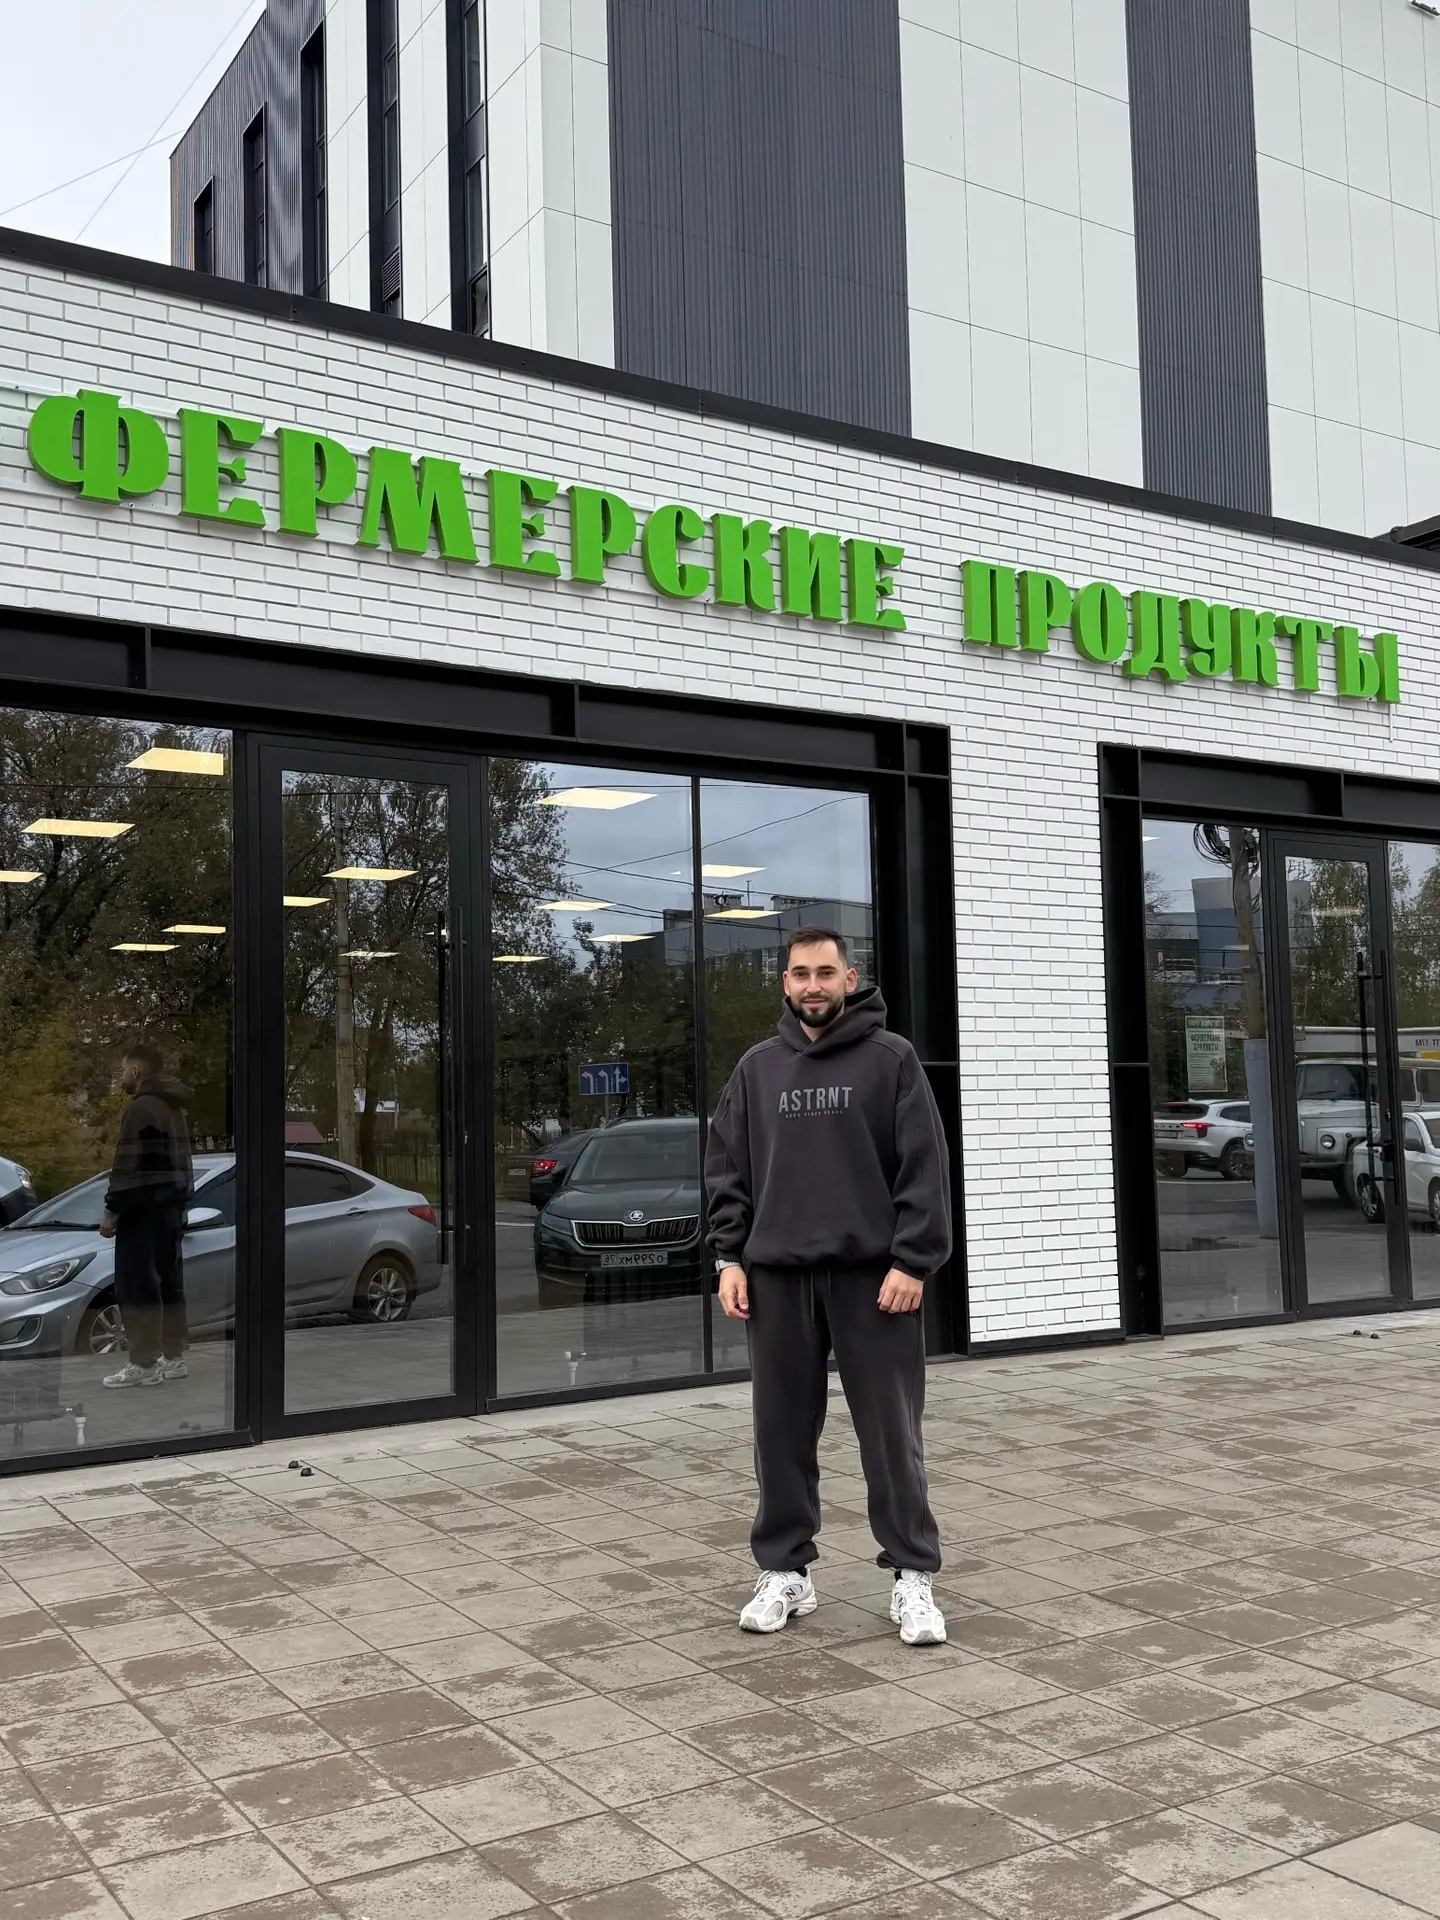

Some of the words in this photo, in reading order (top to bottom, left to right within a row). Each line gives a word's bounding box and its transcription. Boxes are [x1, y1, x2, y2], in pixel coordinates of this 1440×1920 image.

[28, 389, 906, 631] ФЕРМЕРСКИЕ
[960, 559, 1400, 703] ПРОДУКТЫ
[778, 1086, 853, 1113] ASTRNT
